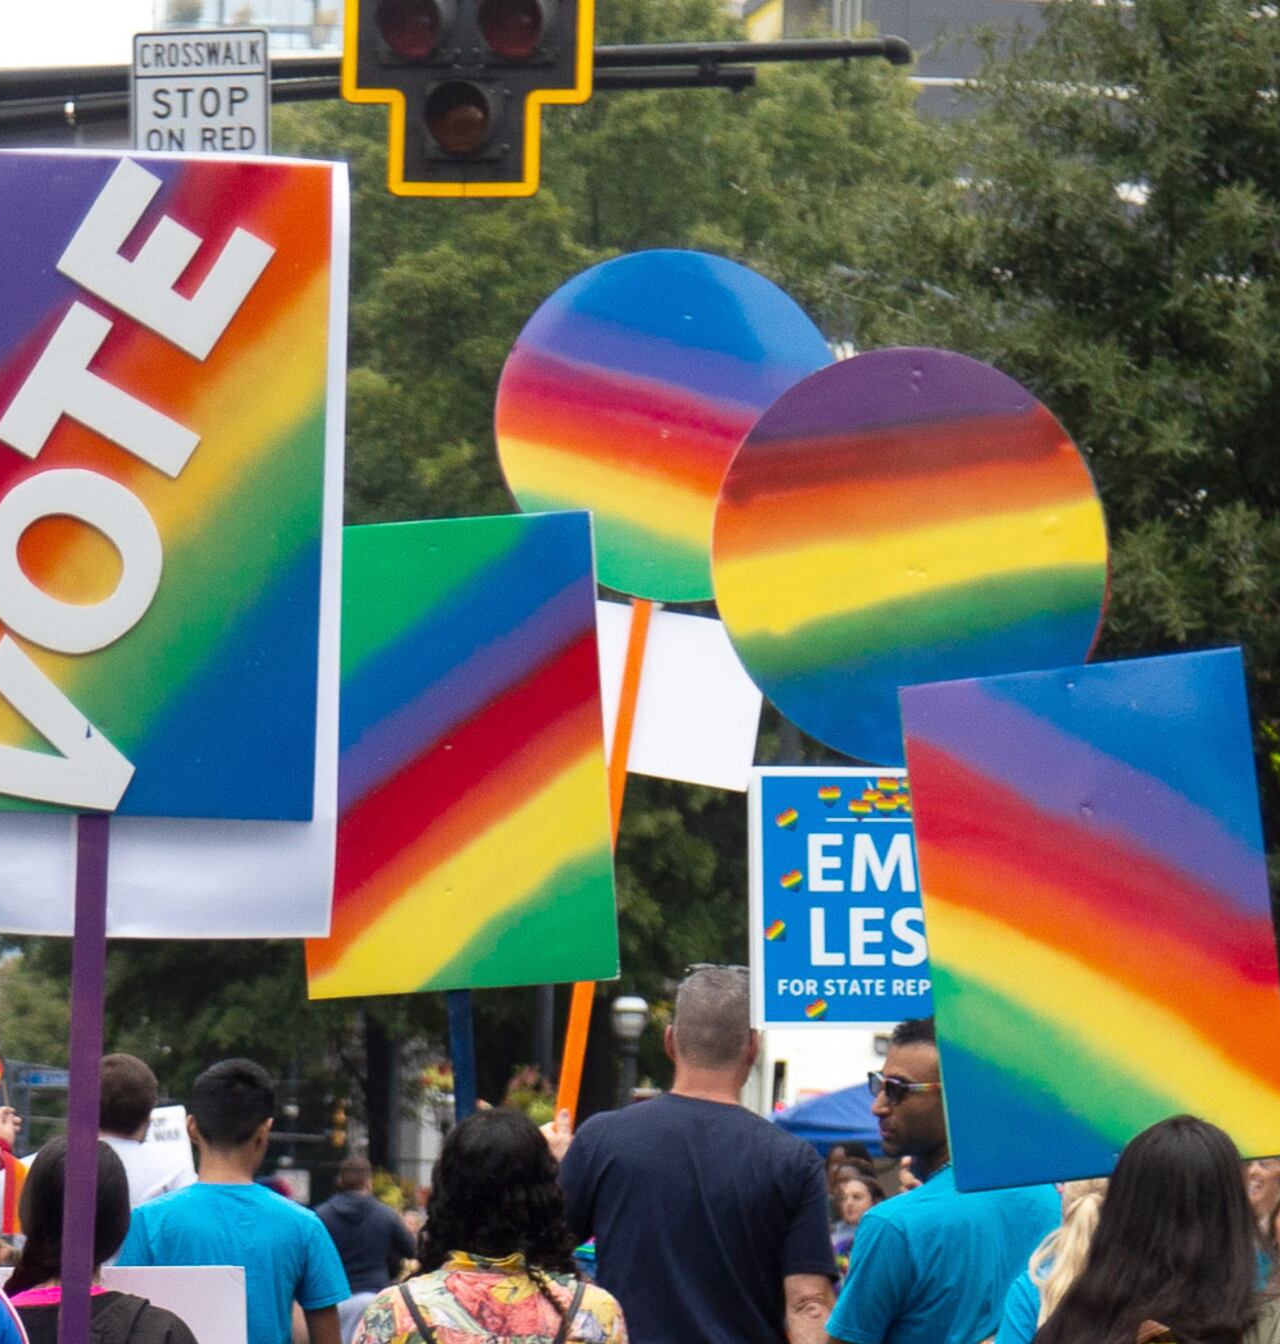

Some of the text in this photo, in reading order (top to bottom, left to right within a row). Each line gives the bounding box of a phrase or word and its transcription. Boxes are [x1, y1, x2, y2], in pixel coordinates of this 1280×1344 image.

[140, 40, 261, 68] CROSSWALK
[153, 86, 249, 119] STOP
[147, 126, 256, 151] ON RED
[807, 833, 917, 892] EM
[810, 907, 929, 967] LES
[778, 979, 932, 996] FOR STATE REP
